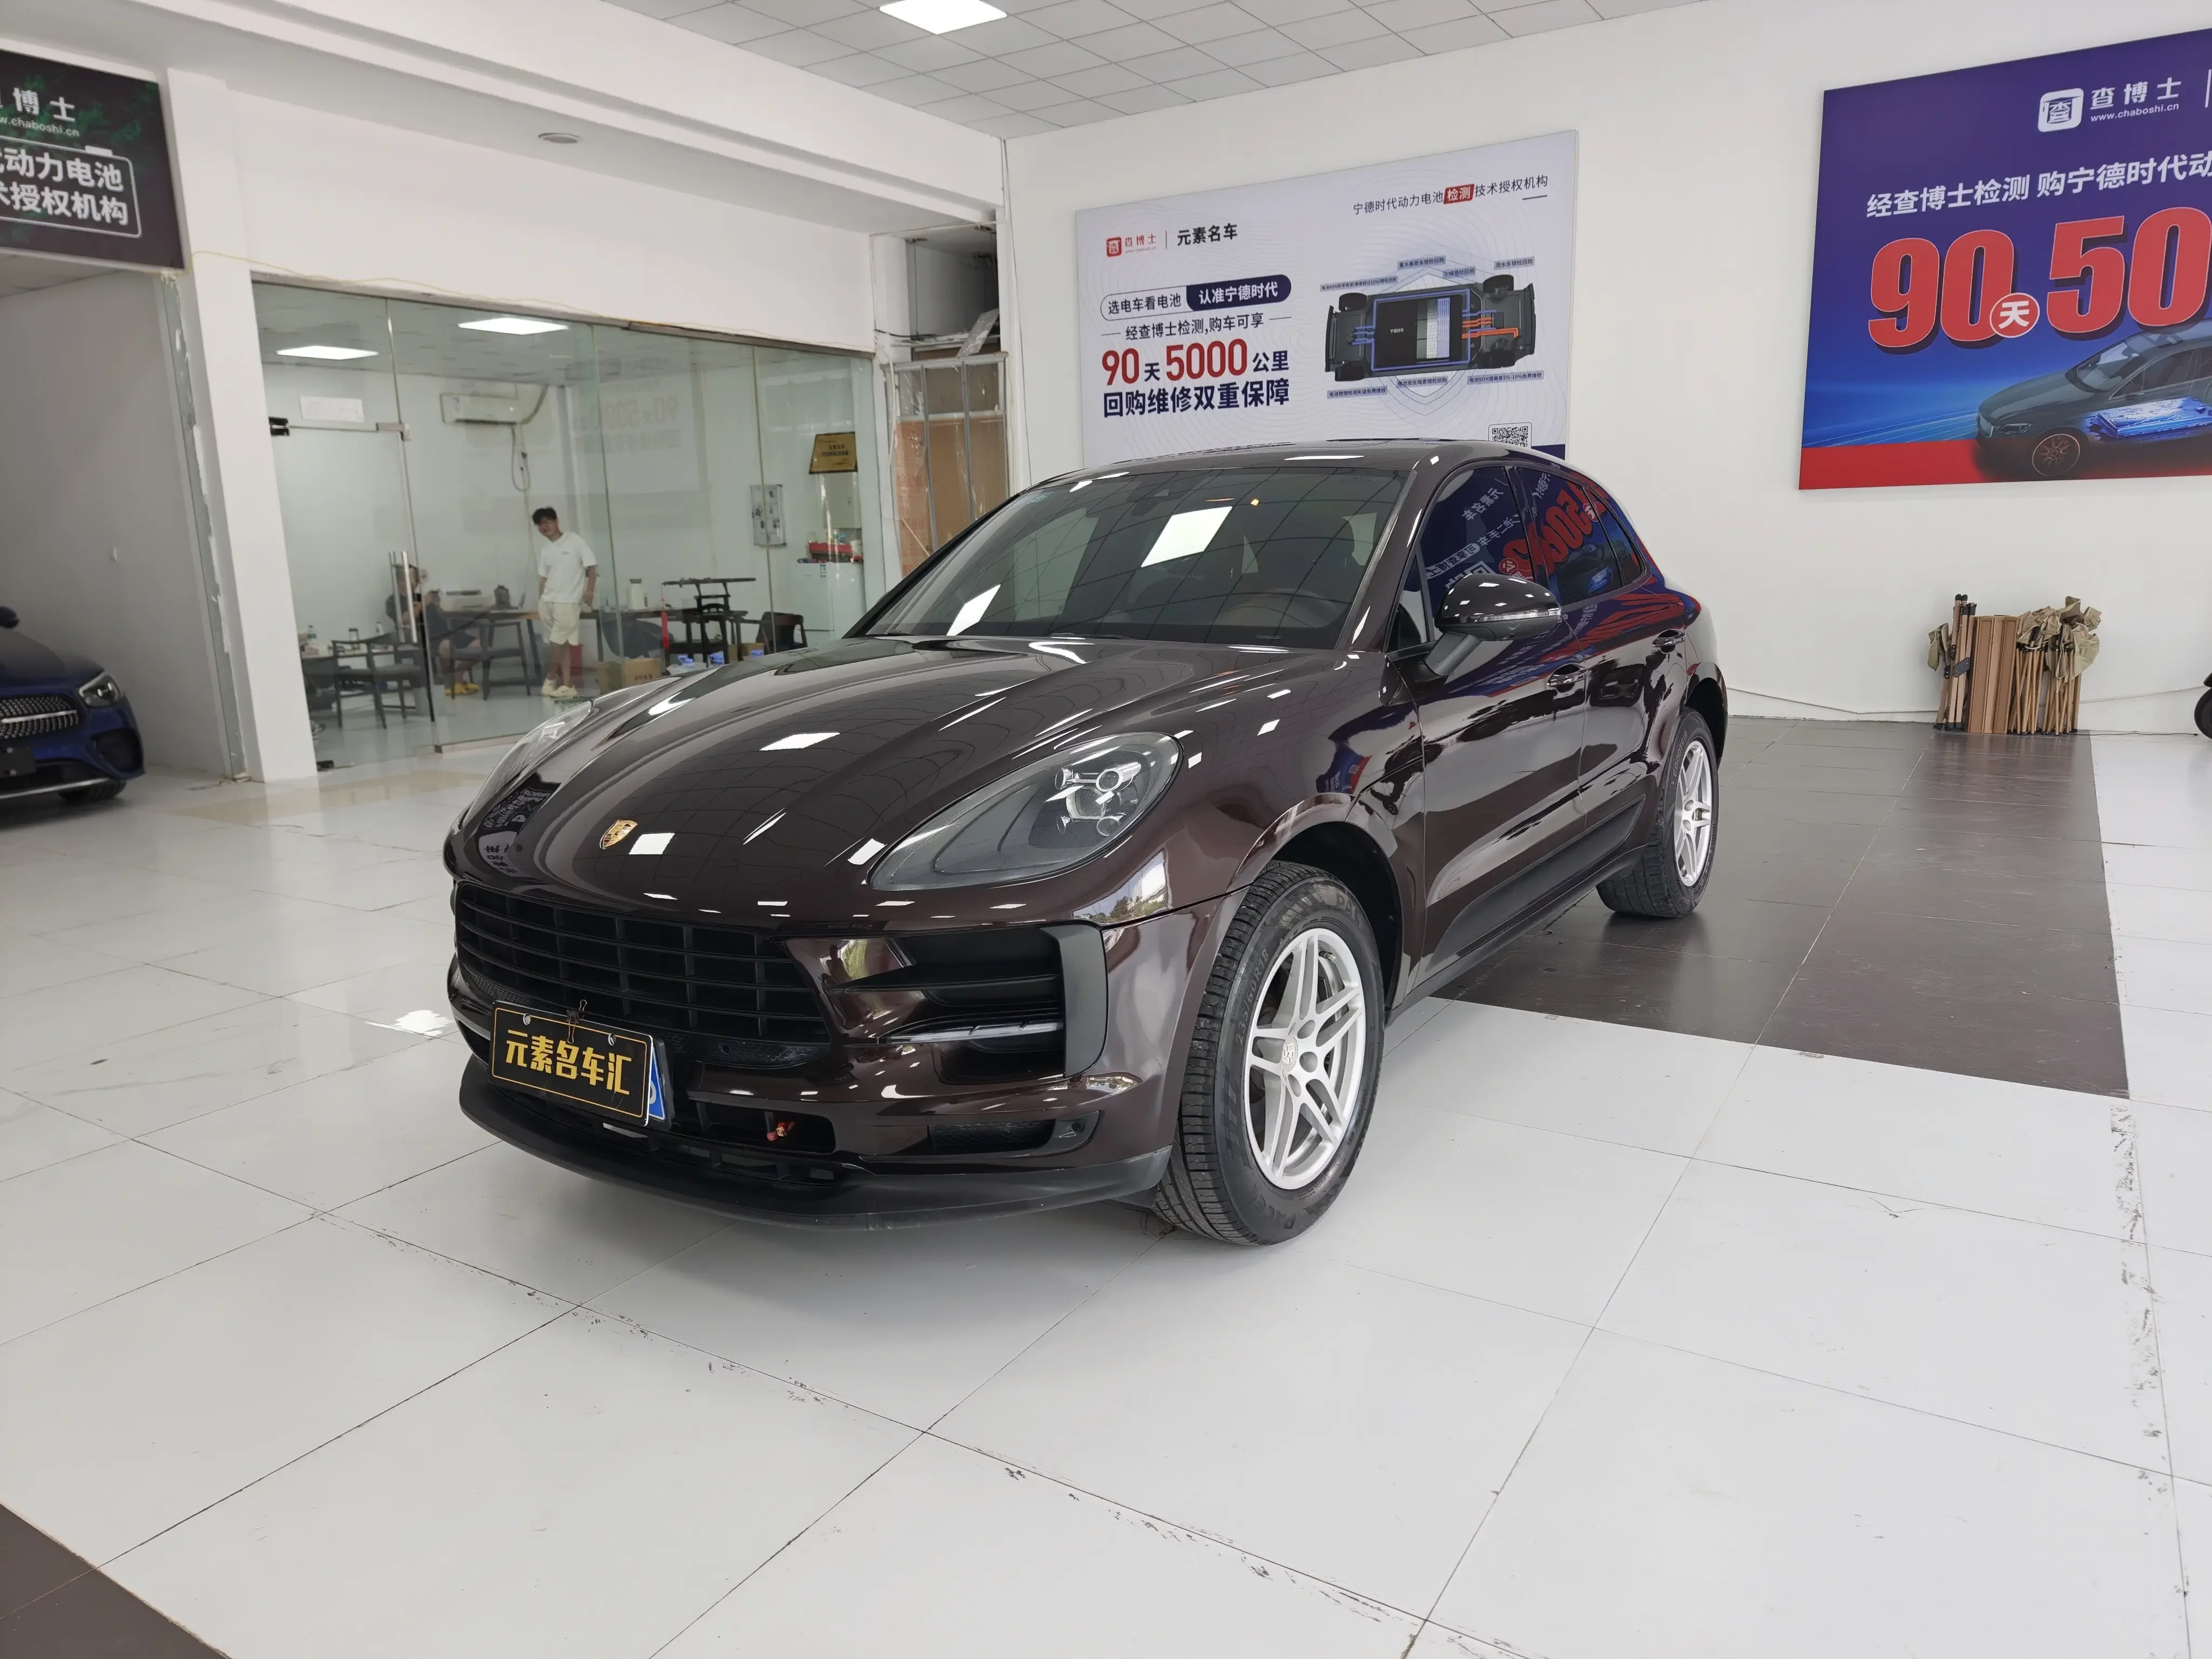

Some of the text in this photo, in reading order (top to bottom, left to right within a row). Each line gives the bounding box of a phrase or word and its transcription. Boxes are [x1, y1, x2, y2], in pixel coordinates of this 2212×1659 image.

[0, 87, 75, 122] 博士
[2090, 77, 2181, 110] 查博士
[2090, 103, 2179, 122] www.chaboshi.cn
[0, 147, 124, 192] 动力电池
[1866, 174, 2029, 218] 经查博士检测
[1177, 222, 1238, 246] 元素名车
[1108, 281, 1278, 314] 选电车看电池 认准宁德时代
[1103, 377, 1290, 417] 回购维修双重保障
[1235, 948, 1269, 1046] 235/60R18
[505, 1029, 632, 1095] 元素名车汇
